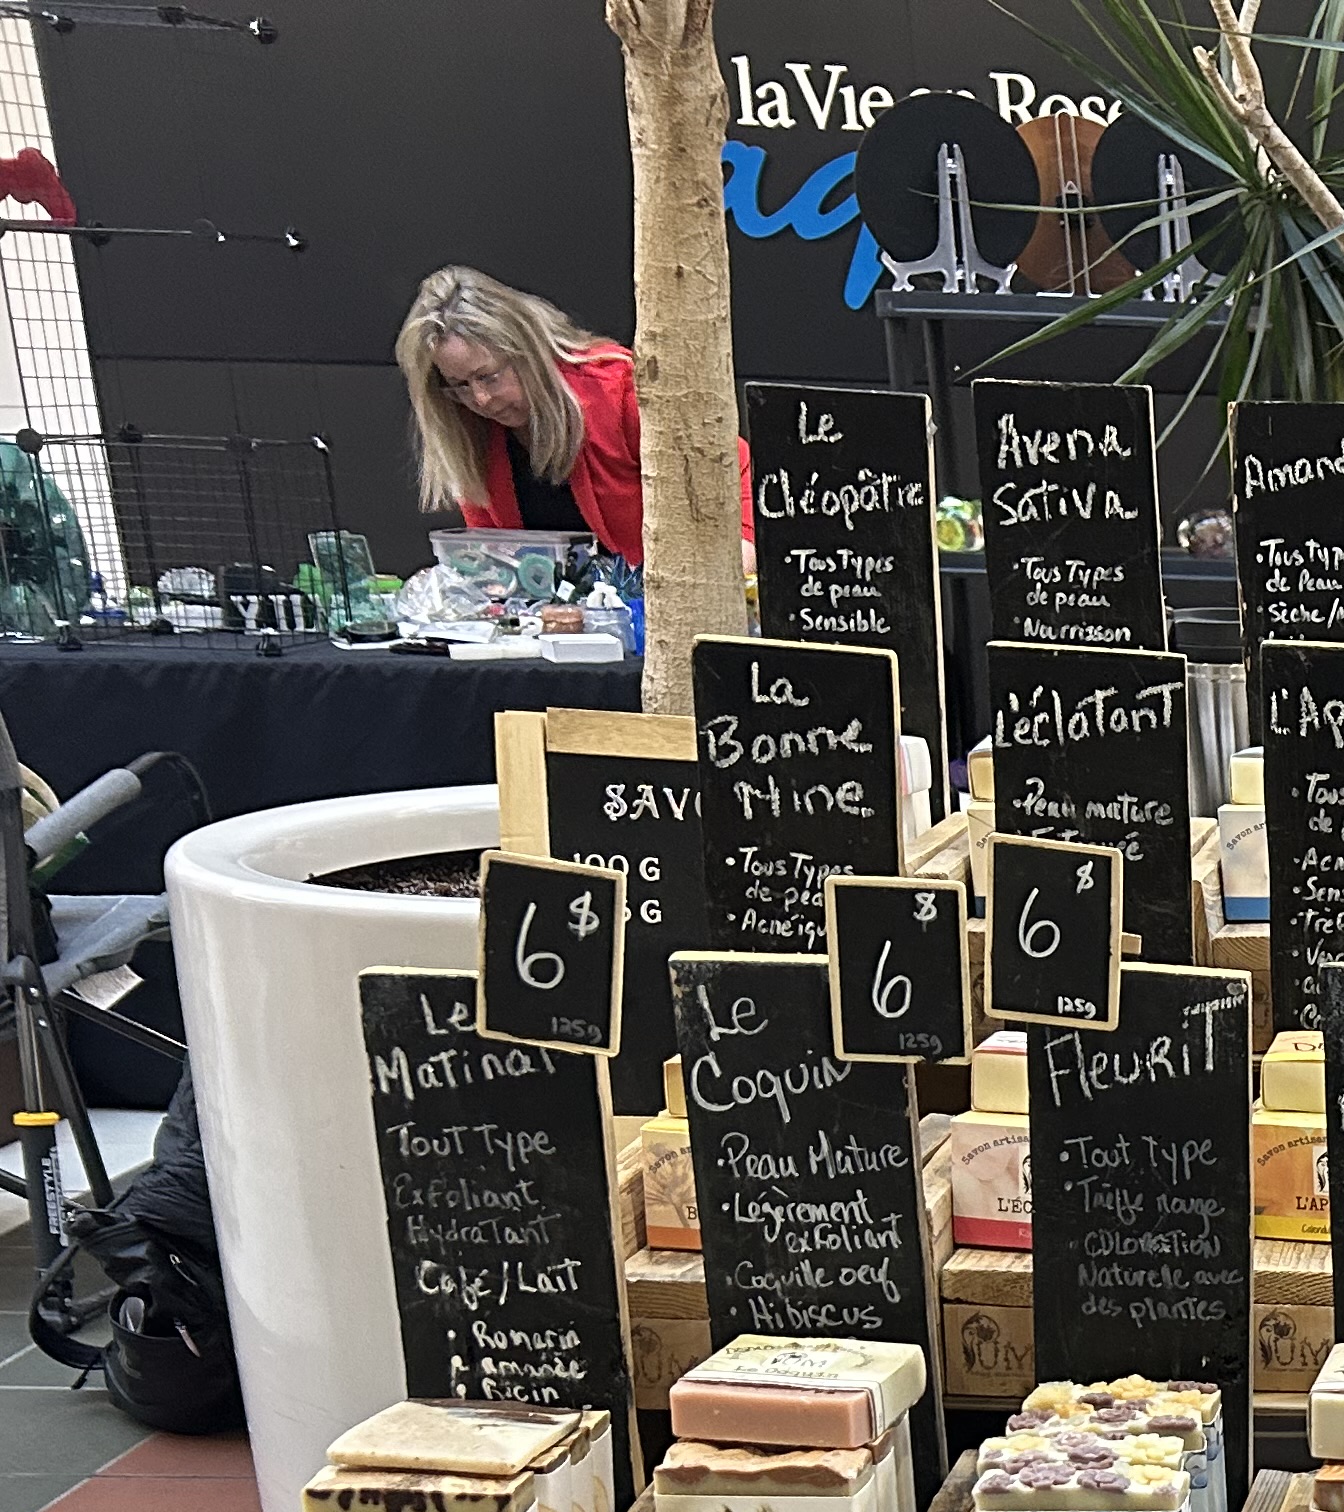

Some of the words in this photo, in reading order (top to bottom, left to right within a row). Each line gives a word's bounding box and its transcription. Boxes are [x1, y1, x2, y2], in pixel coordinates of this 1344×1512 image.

[799, 401, 843, 444] Le
[998, 414, 1132, 468] Avena
[801, 579, 824, 597] de
[1027, 589, 1049, 606] de
[800, 610, 890, 634] Sensible
[1024, 619, 1131, 643] Nourrisson
[751, 661, 809, 708] La
[700, 715, 872, 768] Bonne
[1309, 812, 1332, 834] de
[698, 985, 768, 1041] Le
[721, 1132, 799, 1180] Peau
[735, 1259, 833, 1300] Coquille
[1194, 1271, 1244, 1287] avec
[753, 1297, 882, 1330] Hibiscus
